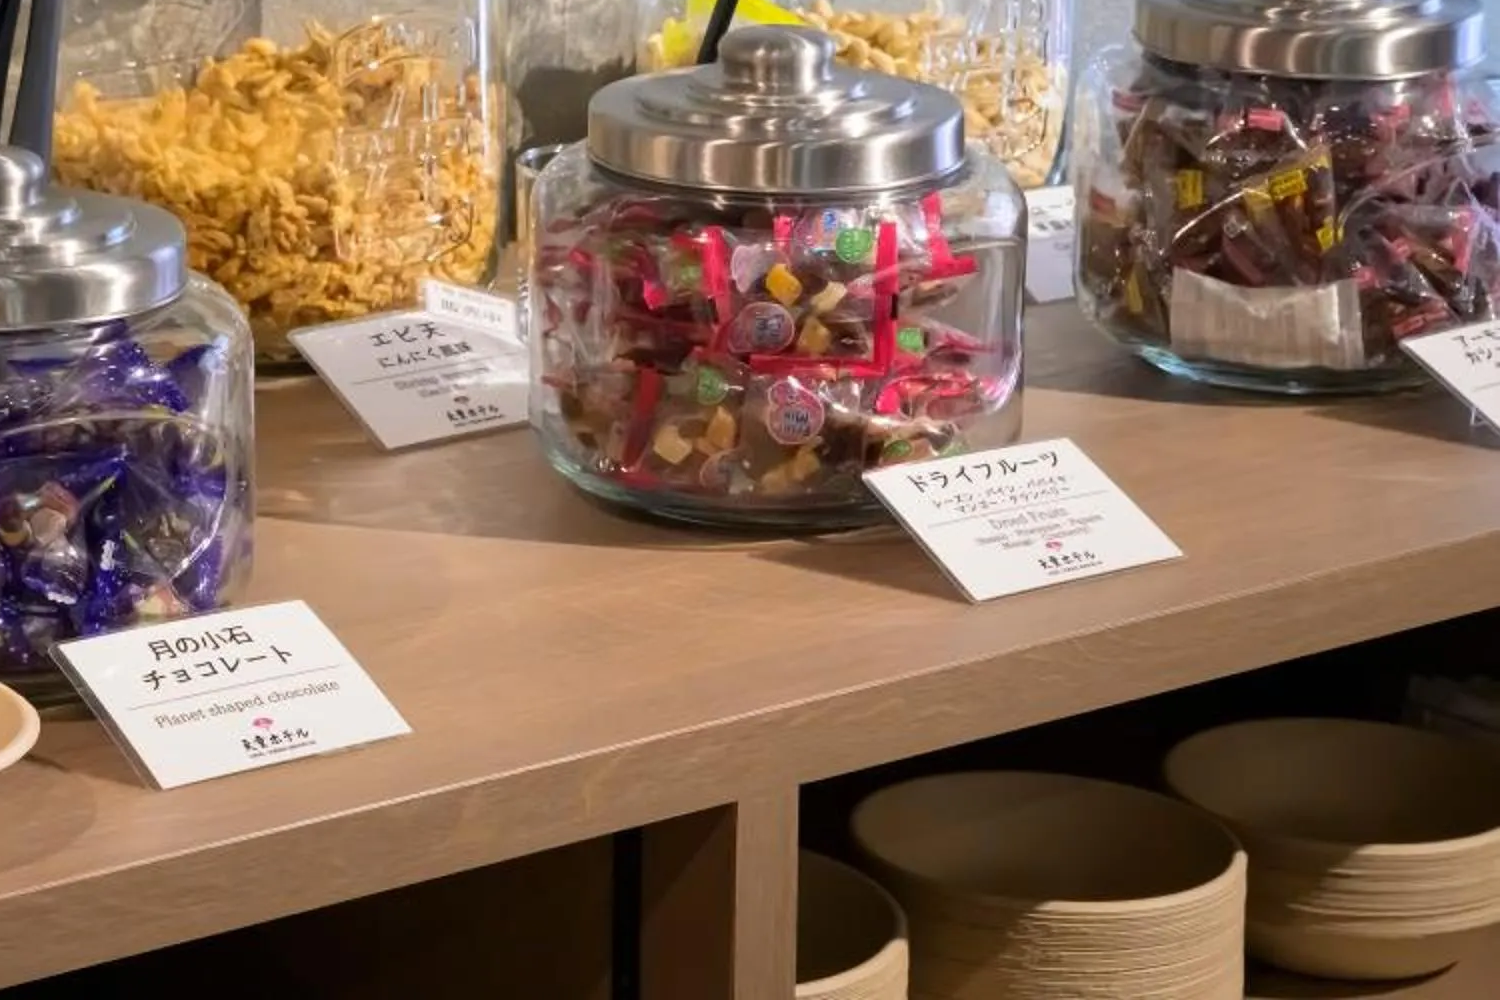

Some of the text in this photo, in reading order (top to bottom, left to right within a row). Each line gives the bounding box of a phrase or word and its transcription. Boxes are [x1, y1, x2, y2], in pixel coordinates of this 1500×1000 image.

[907, 451, 1059, 493] ドライフルーツ
[147, 625, 254, 662] 月の小石
[142, 643, 293, 691] チョコレート
[154, 679, 341, 729] Planet shaped chocolate
